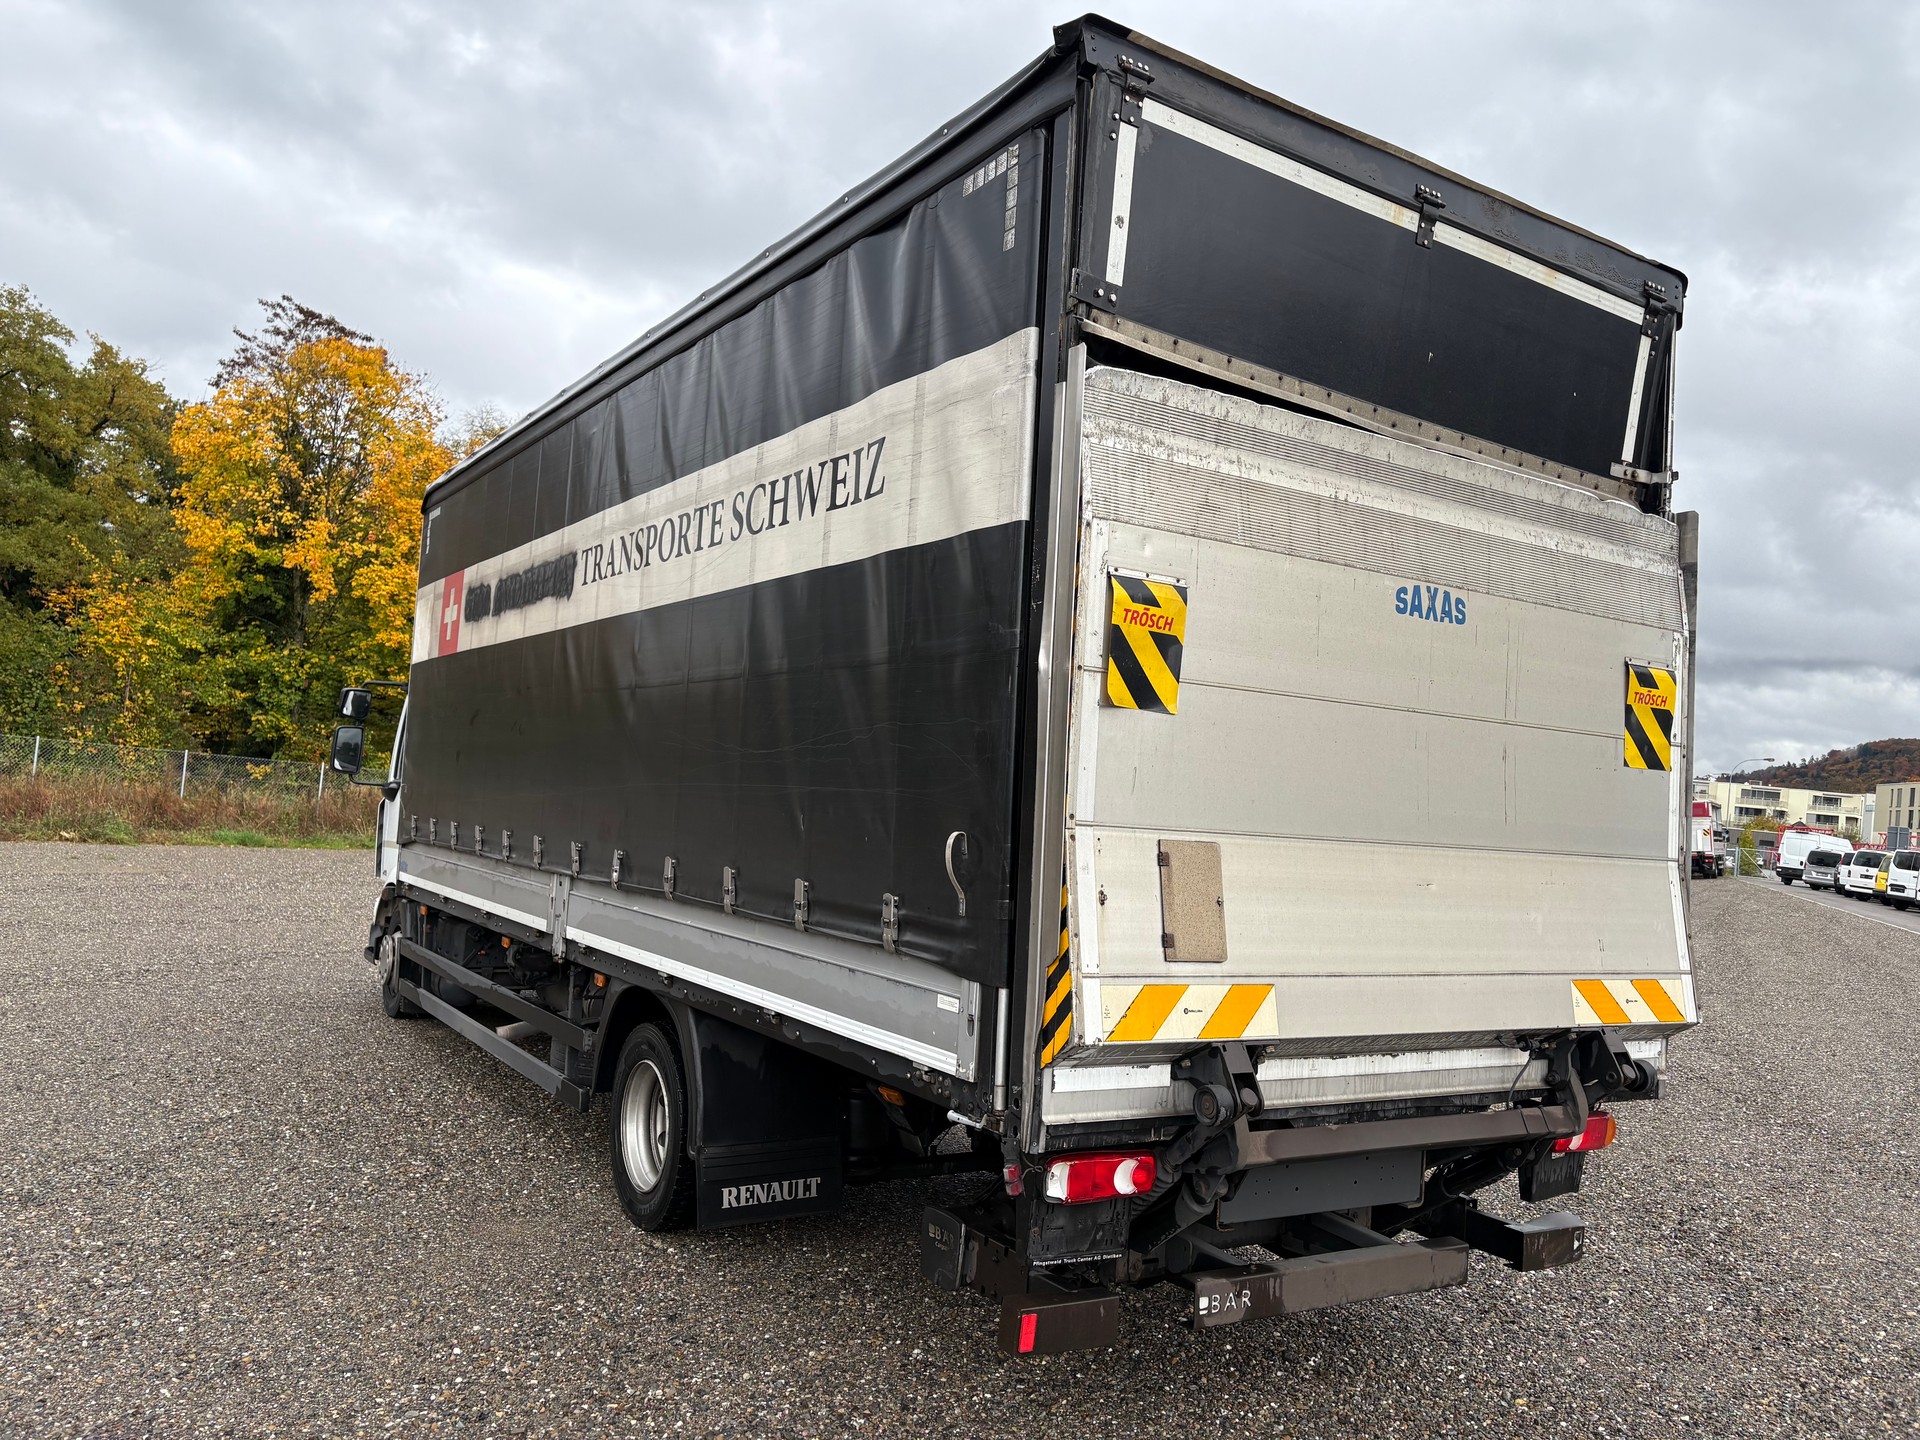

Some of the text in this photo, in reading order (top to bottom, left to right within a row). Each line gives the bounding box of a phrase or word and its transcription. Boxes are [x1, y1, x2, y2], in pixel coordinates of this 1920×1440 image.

[581, 436, 887, 586] TRANSPORTE SCHWEIZ
[1395, 584, 1466, 625] SAXAS
[721, 1177, 821, 1209] RENAULT
